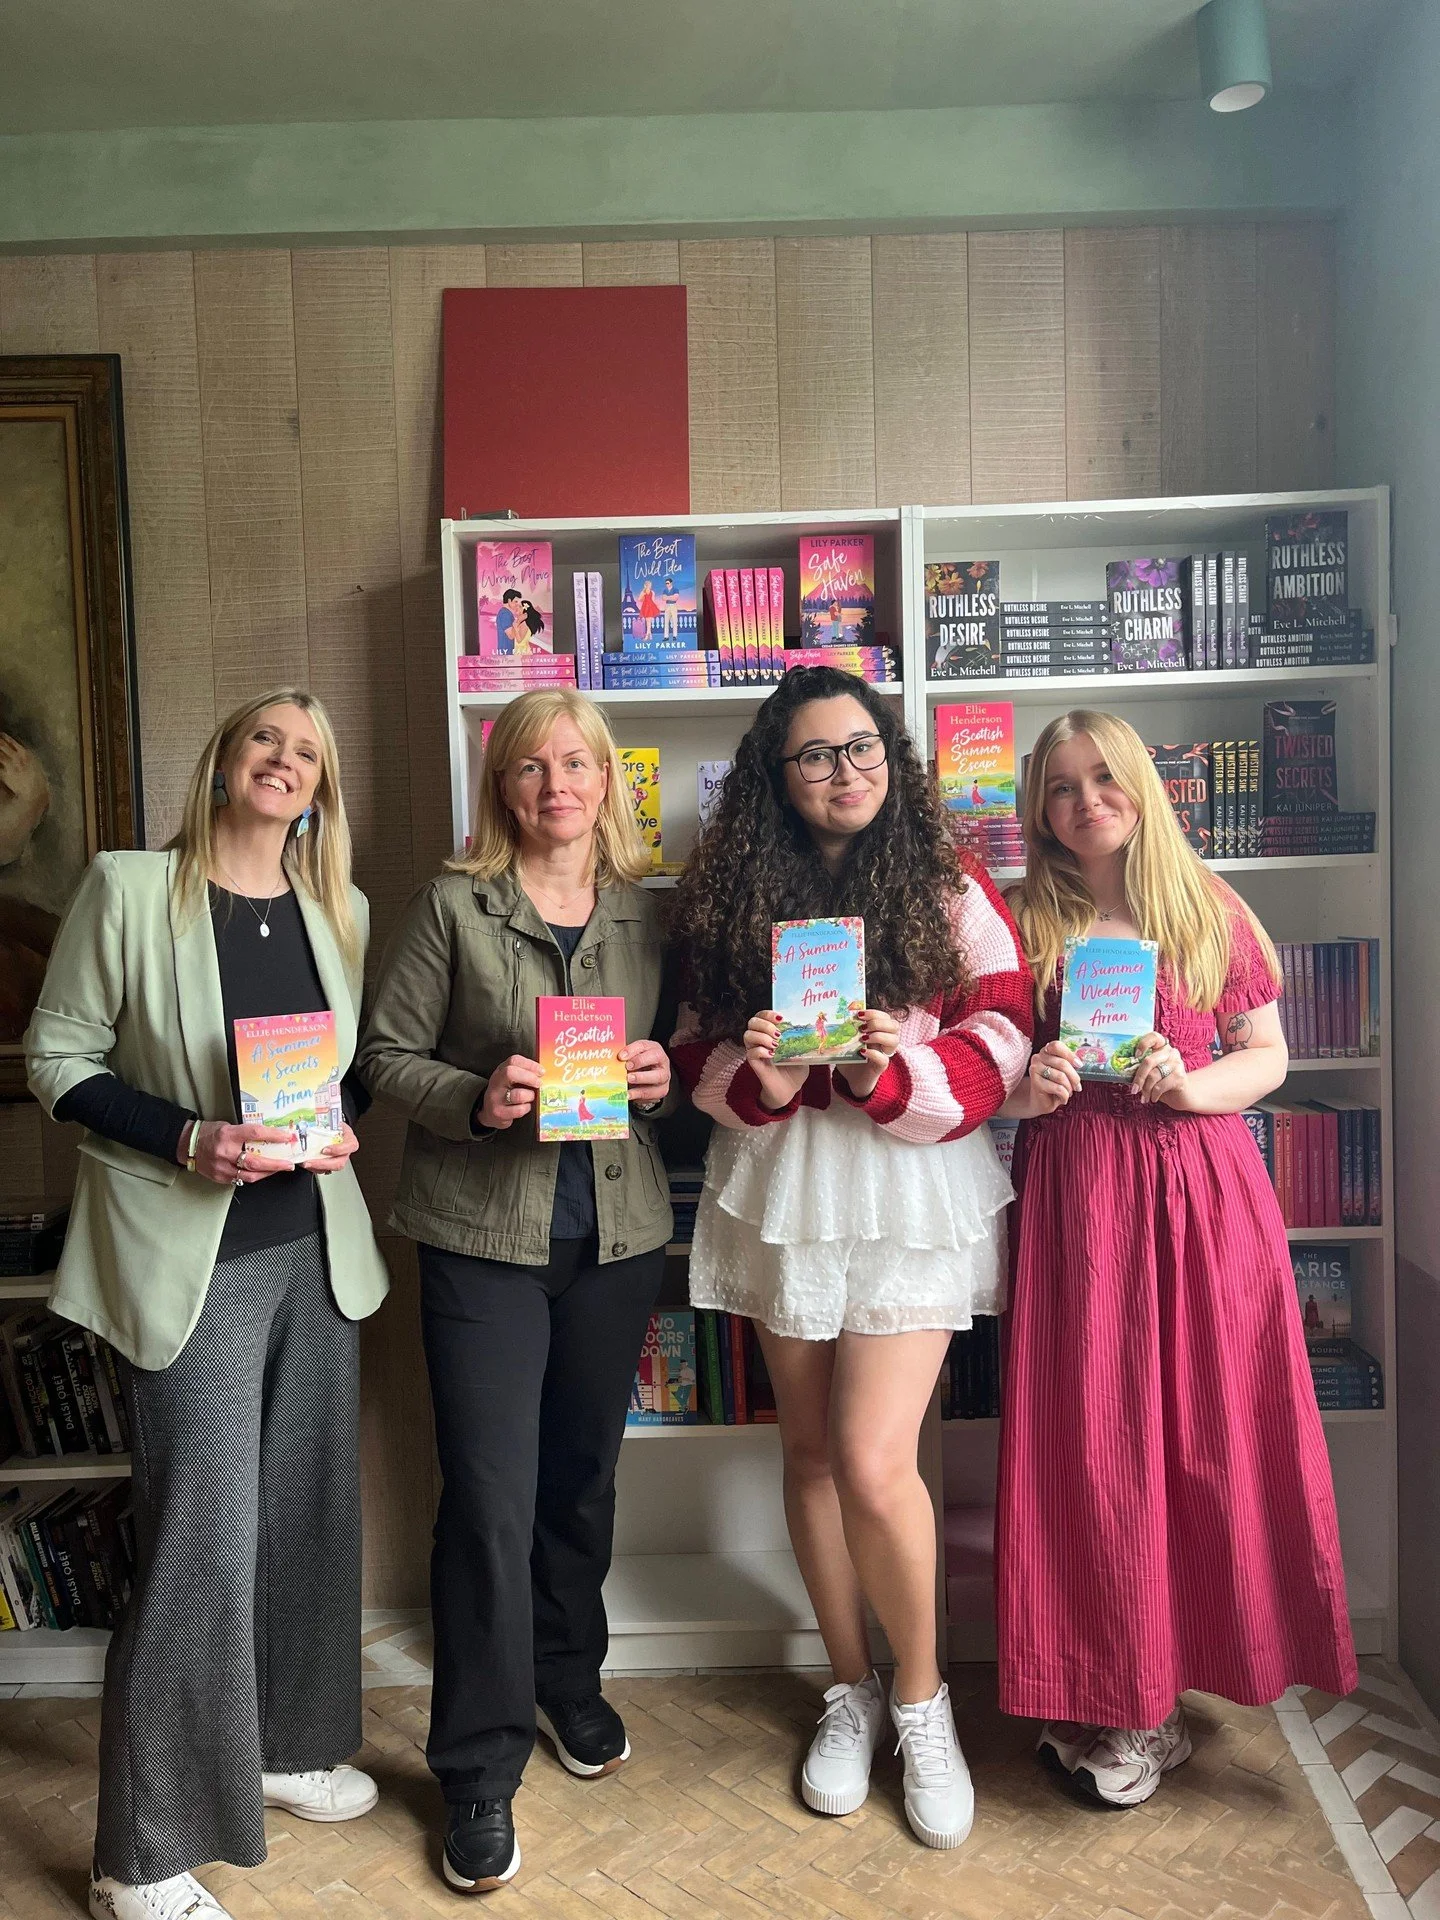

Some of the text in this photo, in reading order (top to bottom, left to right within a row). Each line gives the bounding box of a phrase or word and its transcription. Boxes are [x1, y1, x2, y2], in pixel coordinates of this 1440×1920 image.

[633, 537, 682, 560] The Best
[810, 538, 864, 548] LILY PARKER
[491, 547, 539, 572] The Best
[1272, 541, 1345, 569] RUTHLESS
[634, 558, 682, 580] Wild Idea
[808, 549, 847, 581] Safe
[1194, 560, 1203, 587] RUTHLESS
[481, 565, 549, 588] Wrong Move
[820, 567, 866, 601] Haven
[1273, 571, 1345, 600] AMBITION
[929, 593, 996, 619] RUTHLESS
[1003, 603, 1029, 612] RUTHLESS
[1029, 603, 1048, 612] DESIRE
[1113, 587, 1182, 614] RUTHLESS
[1004, 616, 1049, 625] RUTHLESS DESIRE
[1124, 616, 1173, 641] CHARM
[1273, 615, 1346, 630] Eve L. Mitchell
[939, 622, 986, 647] DESIRE
[1006, 628, 1050, 638] RUTHLESS DESIRE
[1260, 633, 1314, 644] RUTHLESS AMBITION
[492, 647, 542, 656] LILY PARKER
[1007, 641, 1051, 651] RUTHLESS DESIRE
[1260, 645, 1313, 655] RUTHLESS AMBITION
[1006, 654, 1050, 664] RUTHLESS DESIRE
[1117, 657, 1185, 671] Eve L. Mitchell
[1256, 656, 1310, 667] RUTHLESS AMBITION
[930, 664, 996, 677] Eve L. Mitchell
[1006, 667, 1050, 677] RUTHLESS DESIRE
[965, 705, 987, 715] Ellie
[950, 715, 1003, 725] Henderson
[952, 726, 1004, 746] A Scottish
[950, 744, 1003, 762] Summer
[1274, 735, 1333, 760] TWISTED
[957, 759, 998, 775] Escape
[1213, 750, 1224, 778] TWISTED
[1225, 750, 1235, 794] TWISTED SINS
[1215, 779, 1223, 794] SINS
[1275, 766, 1332, 789] SECRETS
[1276, 802, 1333, 813] KAI JUNIPER
[784, 939, 849, 963] A Summer
[801, 963, 839, 979] House
[1075, 960, 1145, 980] A Summer
[801, 988, 839, 1007] Arran
[1080, 982, 1142, 1003] Wedding
[571, 998, 596, 1010] Ellie
[554, 1010, 613, 1022] Henderson
[1089, 1008, 1129, 1027] Arran
[246, 1023, 328, 1038] ELLIE HENDERSON
[555, 1024, 615, 1048] A Scottish
[251, 1036, 321, 1064] A Summer
[554, 1045, 613, 1067] Summer
[275, 1054, 319, 1080] Secrets
[562, 1062, 608, 1084] Escape
[273, 1087, 314, 1110] Arran
[1302, 1252, 1318, 1260] THE
[1293, 1261, 1342, 1278] ARIS
[1297, 1280, 1346, 1290] ISTANCE
[648, 1317, 674, 1330] WO
[645, 1331, 684, 1344] OORS
